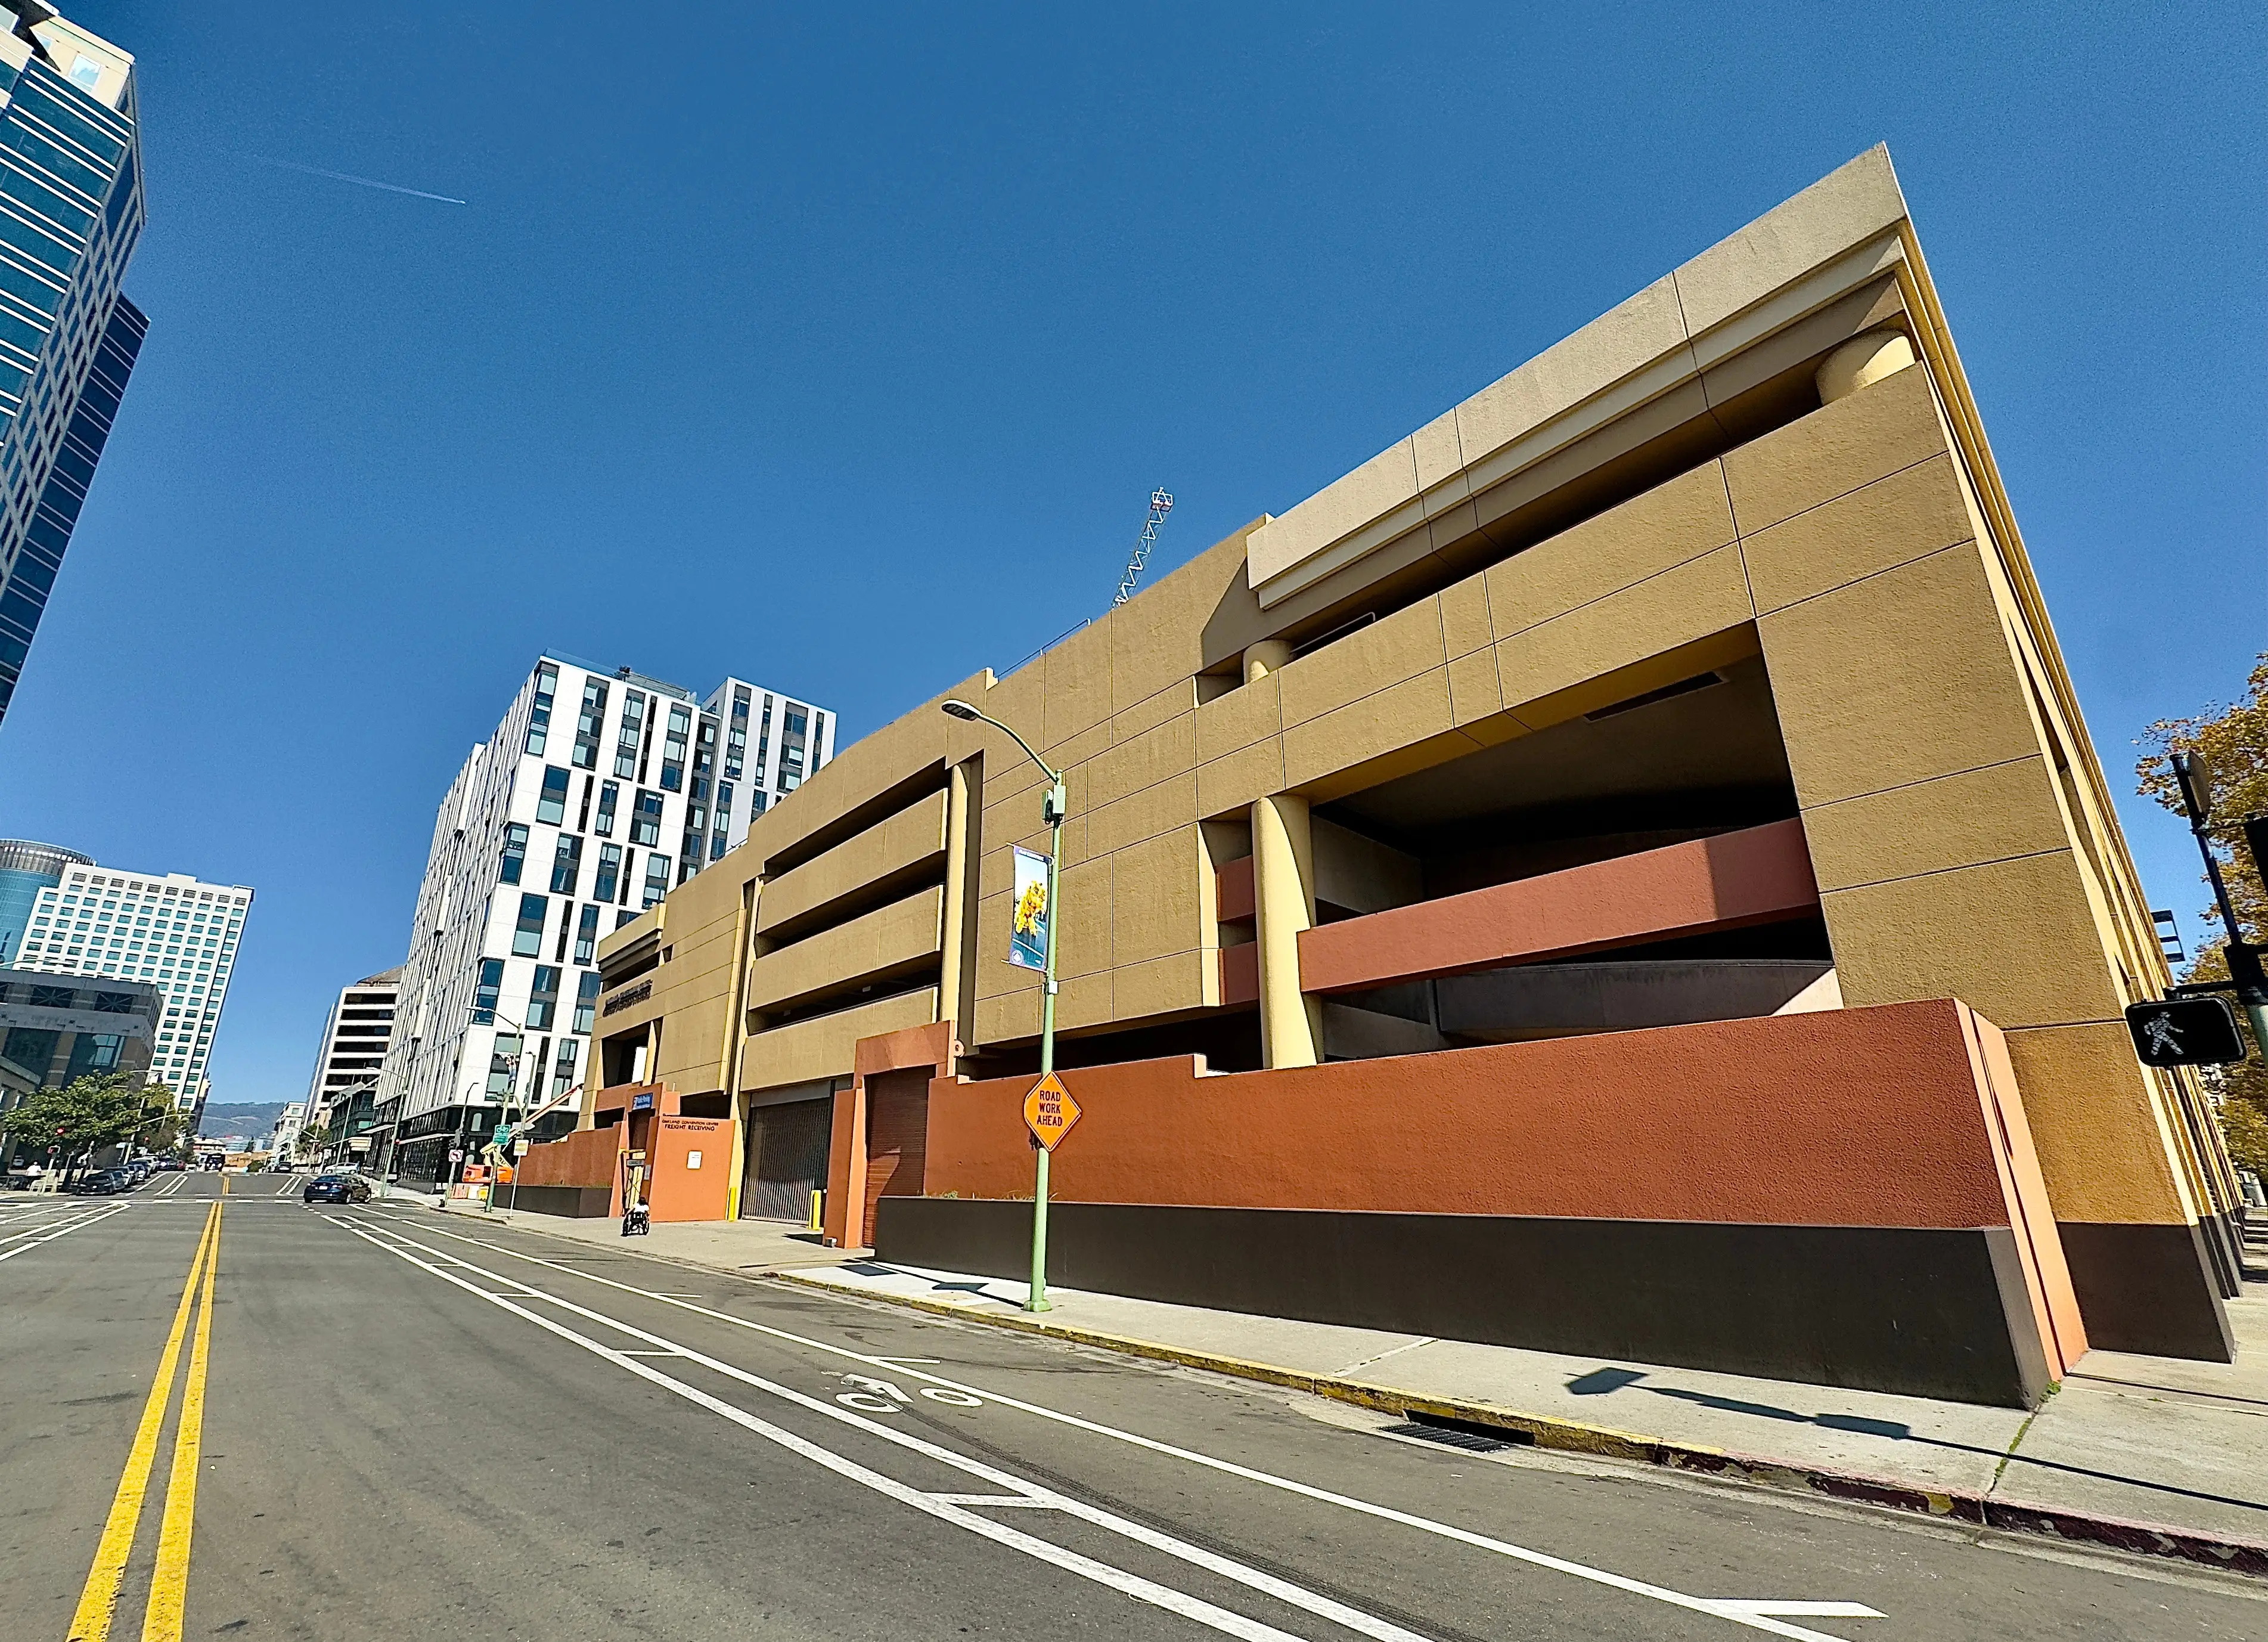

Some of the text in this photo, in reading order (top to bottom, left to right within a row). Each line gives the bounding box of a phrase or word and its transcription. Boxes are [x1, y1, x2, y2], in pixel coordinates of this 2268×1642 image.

[1040, 1090, 1061, 1102] ROAD
[1039, 1102, 1061, 1114] WORK
[1037, 1114, 1063, 1127] AHEAD
